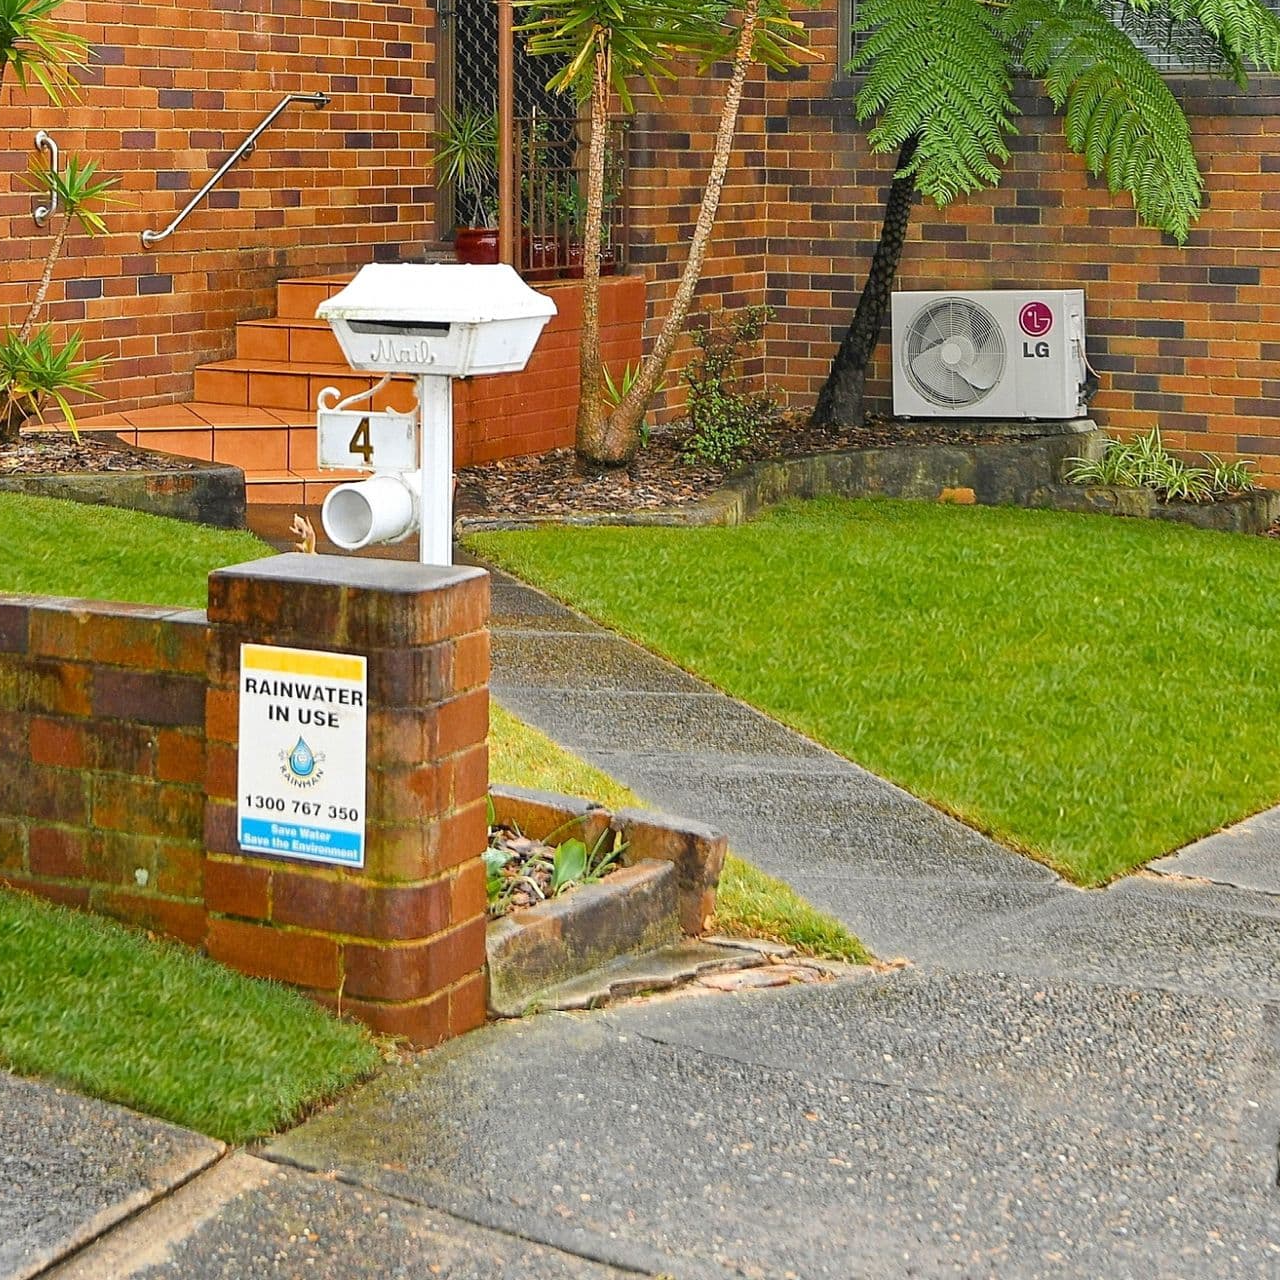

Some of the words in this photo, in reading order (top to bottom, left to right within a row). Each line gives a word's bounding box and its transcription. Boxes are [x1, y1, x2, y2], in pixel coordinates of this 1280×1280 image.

[370, 339, 434, 365] Mail
[1023, 342, 1050, 358] LG
[349, 417, 373, 464] 4
[245, 677, 363, 707] RAINWATER
[268, 704, 289, 722] IN
[298, 707, 340, 728] USE
[280, 765, 324, 788] RAINMAN
[246, 794, 285, 812] 1300
[291, 800, 322, 816] 767
[328, 805, 359, 821] 350
[271, 823, 297, 837] Save
[299, 827, 331, 842] Water
[243, 832, 270, 846] Save
[272, 836, 290, 849] the
[292, 839, 358, 860] Environment
